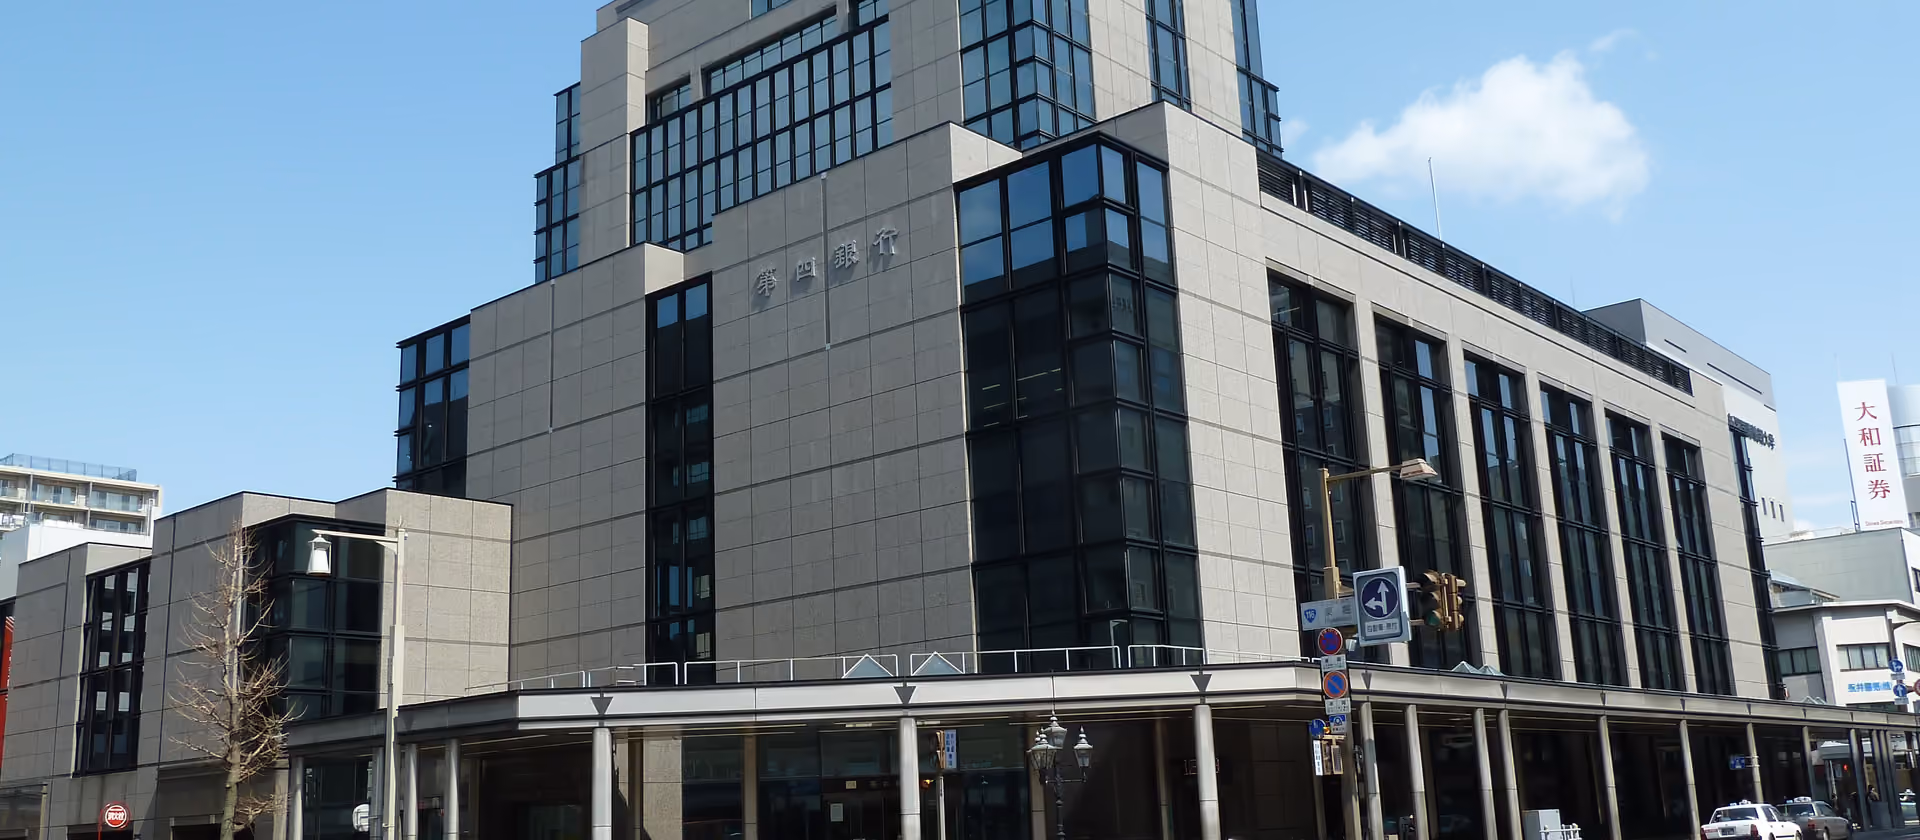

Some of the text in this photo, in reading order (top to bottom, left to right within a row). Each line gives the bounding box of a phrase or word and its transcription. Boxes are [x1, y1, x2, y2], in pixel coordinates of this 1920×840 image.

[756, 226, 900, 298] 第四銀行
[1854, 401, 1891, 501] 大和証券
